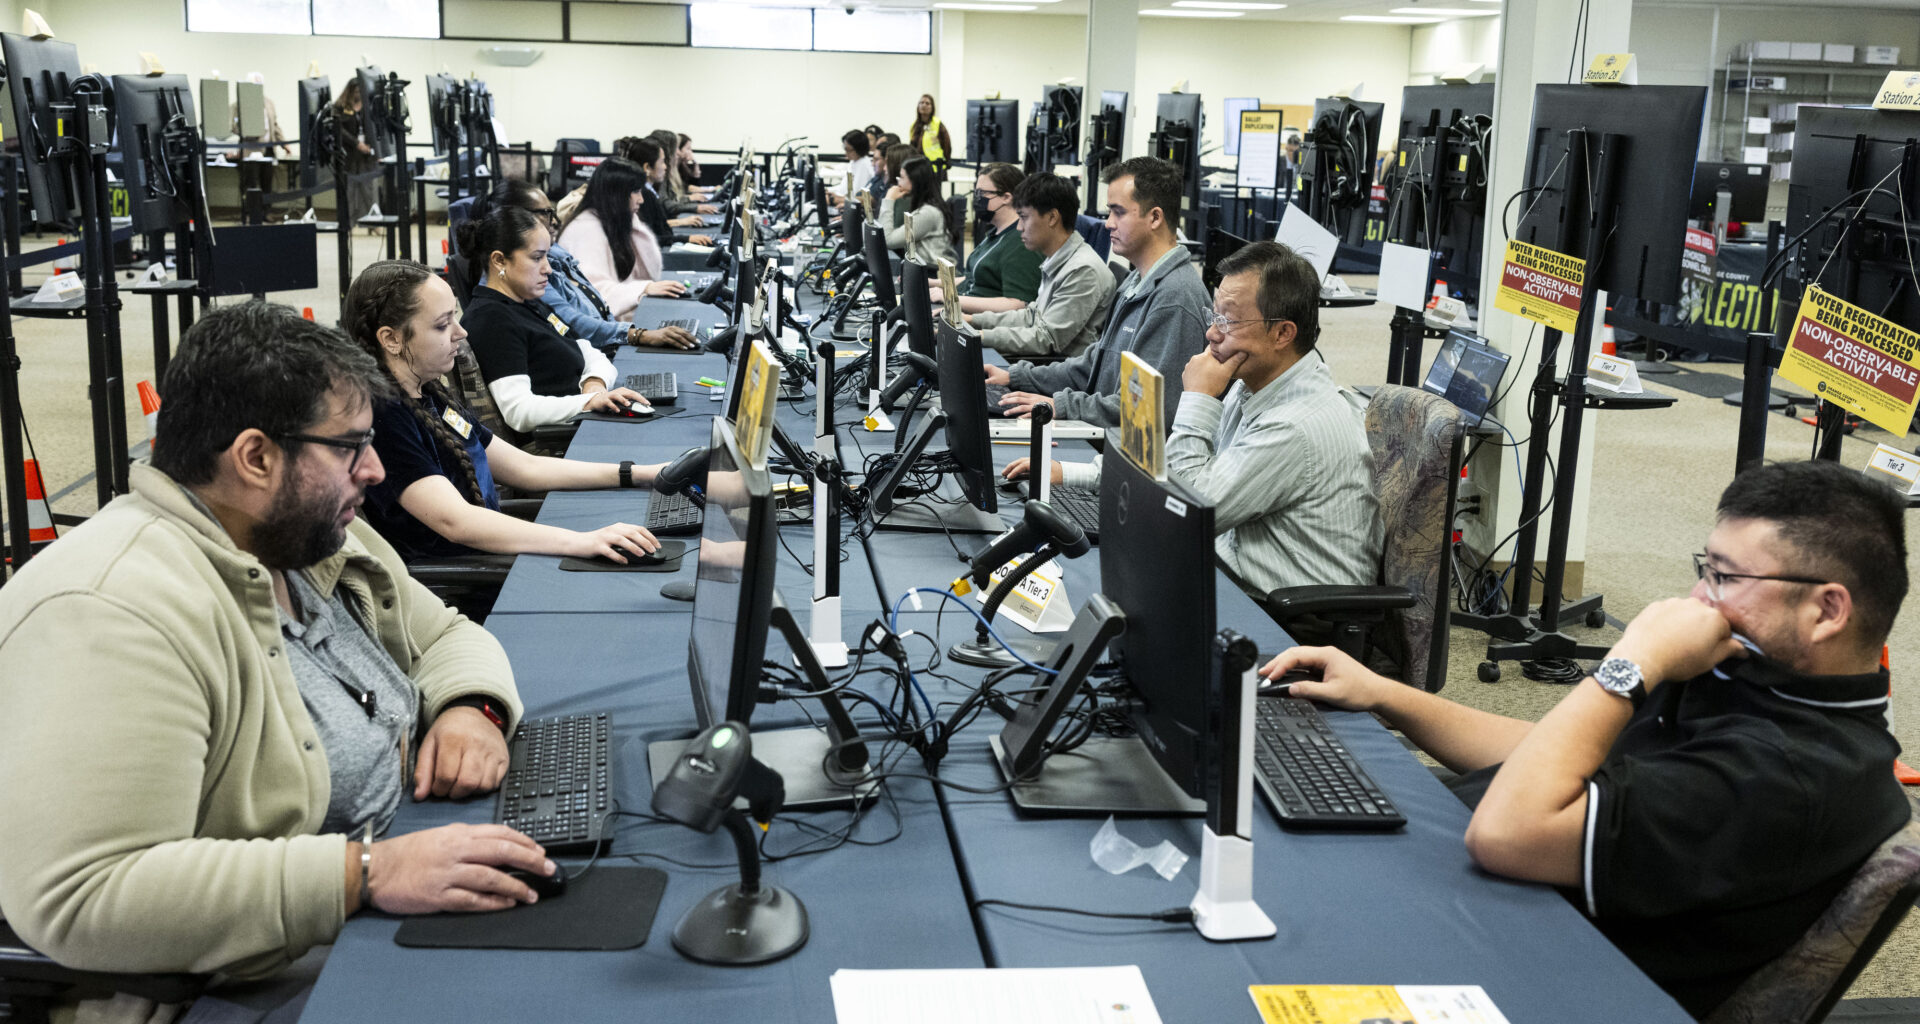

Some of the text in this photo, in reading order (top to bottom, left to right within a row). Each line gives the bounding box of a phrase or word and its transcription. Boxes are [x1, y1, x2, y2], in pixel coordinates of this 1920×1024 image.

[1585, 70, 1620, 80] Station 28
[1880, 91, 1920, 105] Station 2
[1510, 241, 1532, 256] VOTER
[1516, 254, 1582, 282] BEING PROCESSED
[1506, 264, 1582, 298] NON-OBSERVABL
[1523, 282, 1564, 302] ACTIVITY
[1810, 290, 1920, 351] VOTER REGISTRATION
[1816, 309, 1914, 362] BEING PROCESSED
[1800, 322, 1918, 386] NON-OBSERVABLE
[1824, 349, 1883, 384] ACTIVITY
[1888, 459, 1904, 472] Tier 3
[1027, 580, 1042, 597] Tier
[1042, 589, 1049, 600] 3
